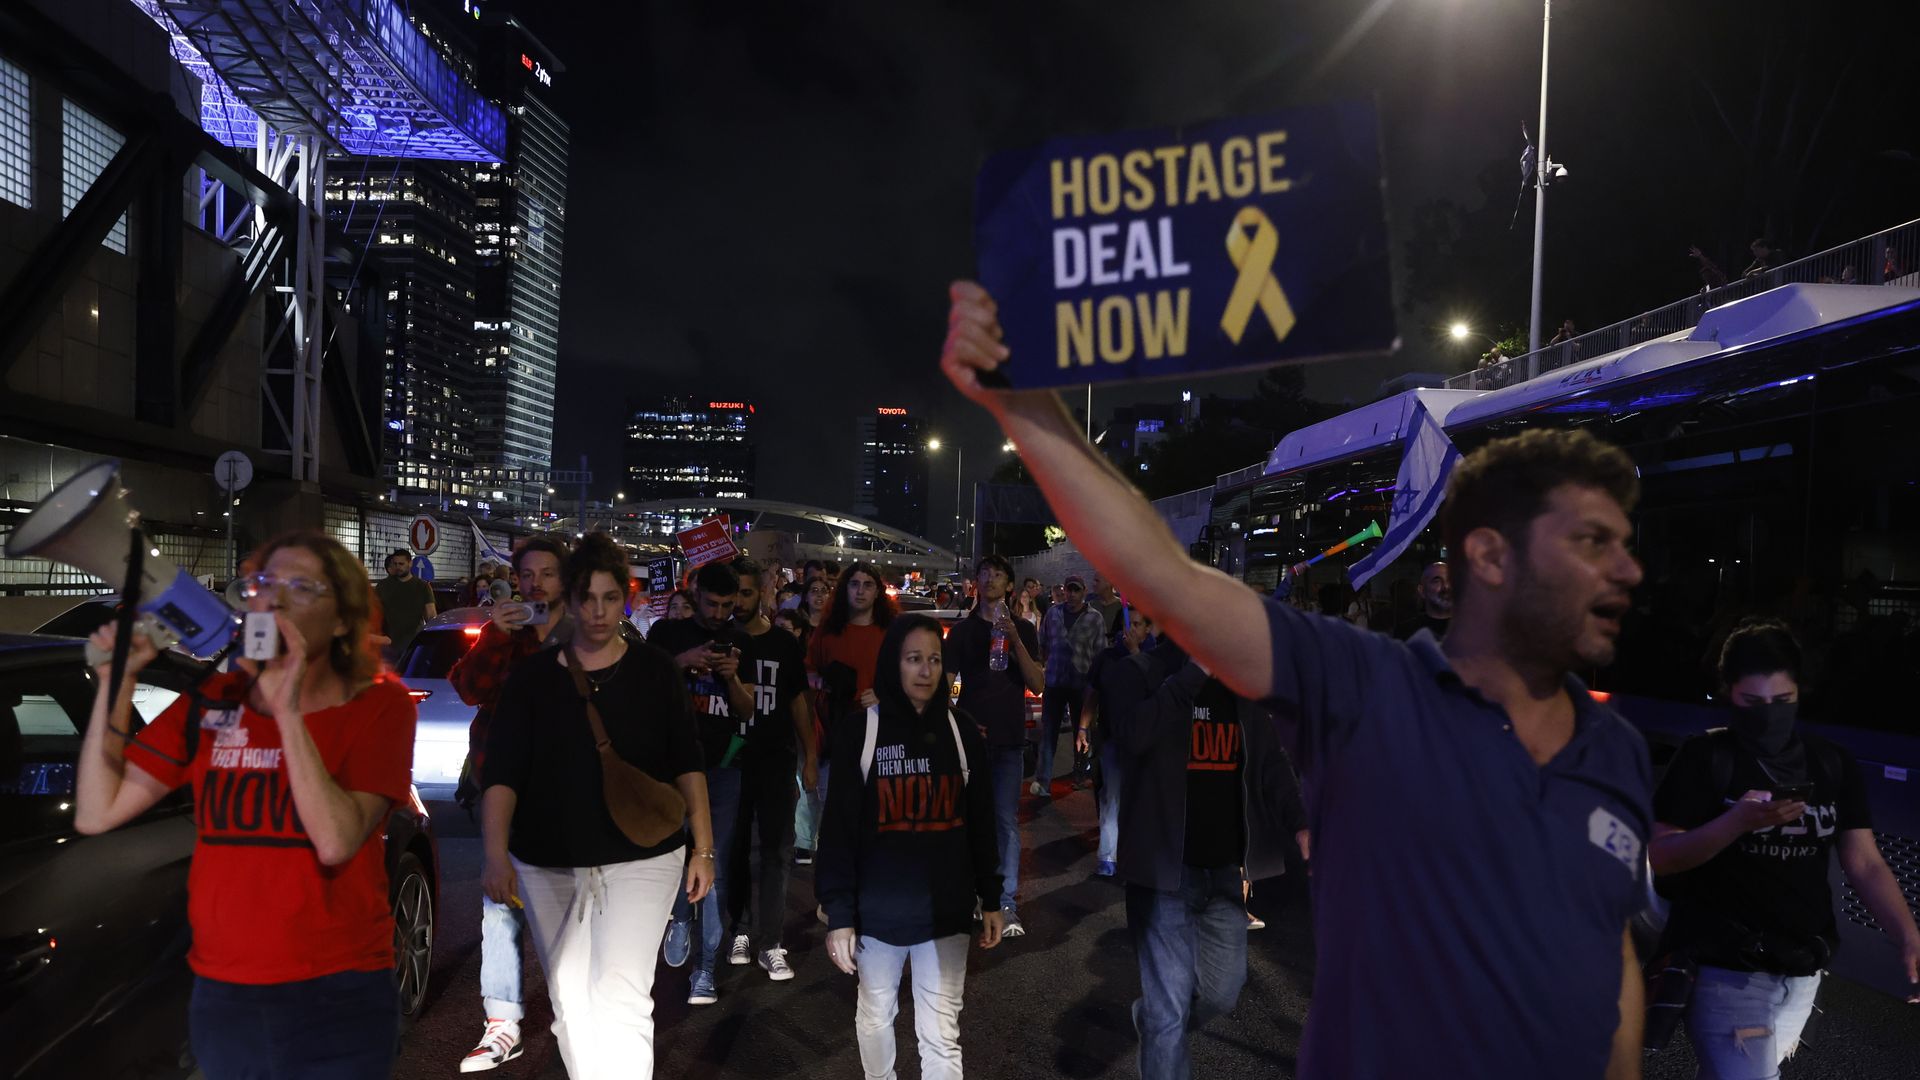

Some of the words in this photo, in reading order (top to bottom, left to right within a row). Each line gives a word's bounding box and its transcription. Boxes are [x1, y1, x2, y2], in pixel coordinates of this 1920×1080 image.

[1051, 131, 1291, 219] HOSTAGE
[1053, 217, 1190, 289] DEAL
[1056, 289, 1191, 368] NOW
[709, 401, 744, 409] SUZUKI
[877, 407, 907, 415] TOYOTA
[876, 744, 905, 761] BRING
[877, 760, 903, 776] THEM
[905, 758, 931, 774] HOME
[876, 772, 960, 823] NOW
[1742, 843, 1818, 861] באוקטוב
